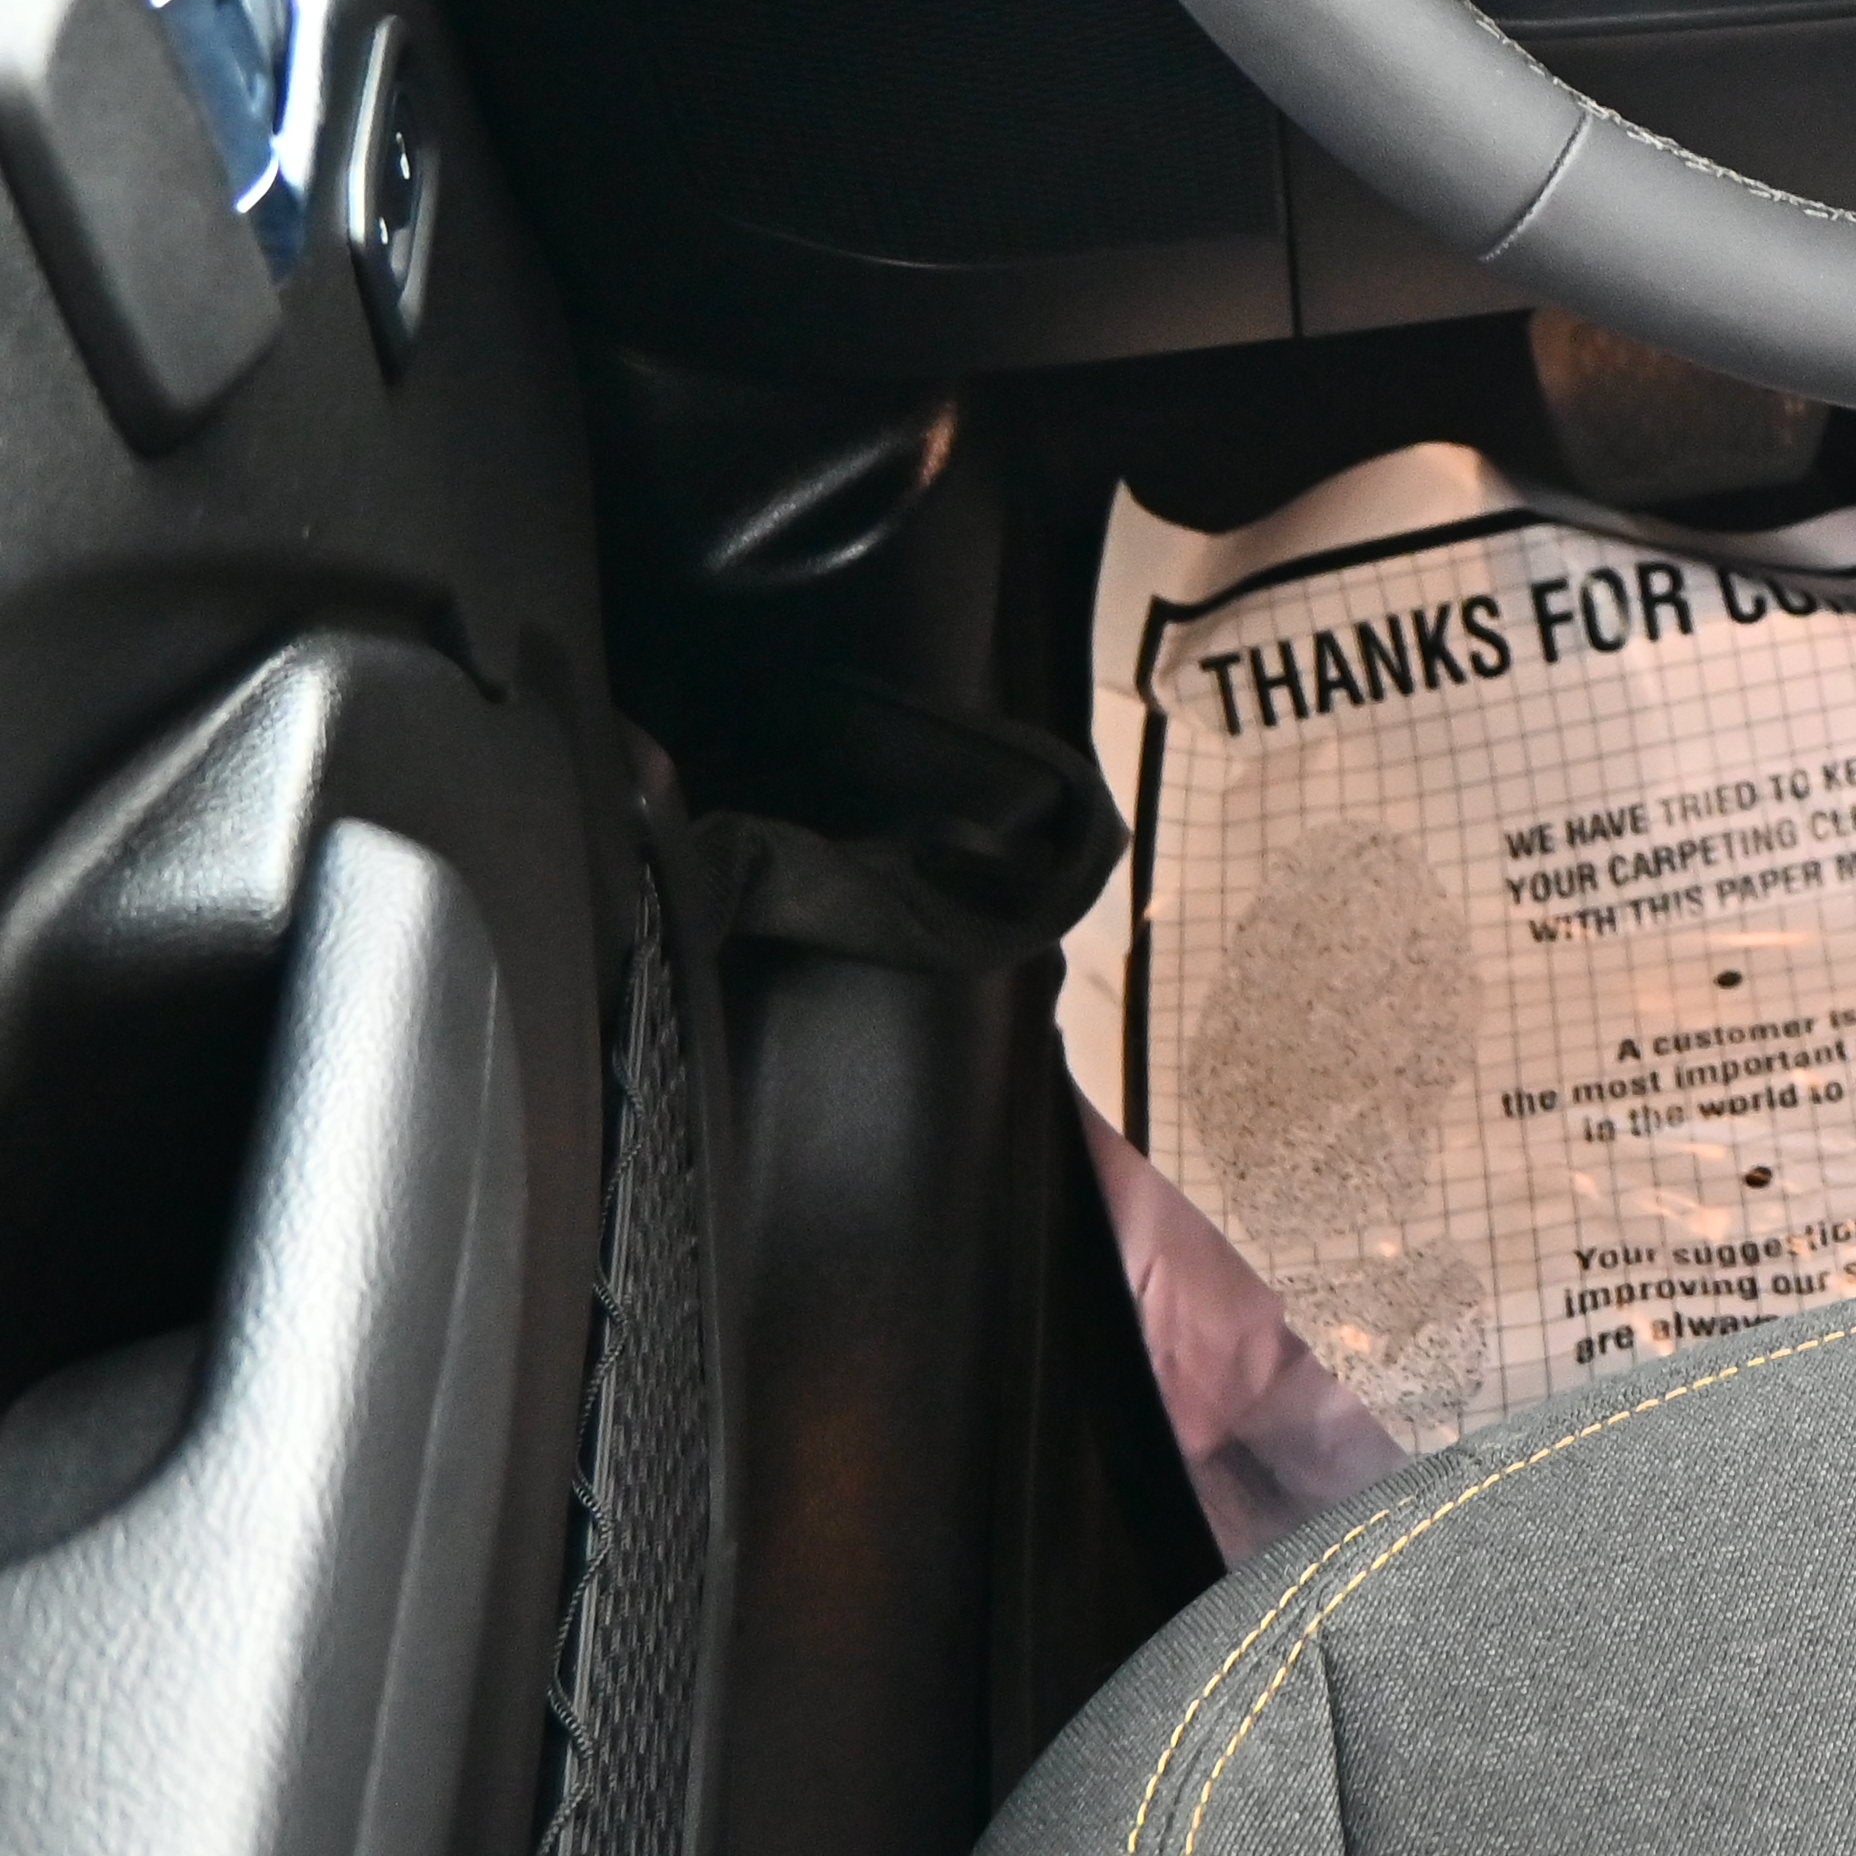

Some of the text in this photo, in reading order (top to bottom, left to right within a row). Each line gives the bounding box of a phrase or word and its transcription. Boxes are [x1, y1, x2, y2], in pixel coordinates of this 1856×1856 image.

[1199, 594, 1513, 738] THANKS
[1530, 561, 1694, 665] FOR
[1503, 819, 1557, 861] WE
[1565, 802, 1650, 849] HAVE
[1660, 779, 1758, 828] TRIED
[1768, 768, 1812, 804] TO
[1505, 860, 1600, 906] YOUR
[1607, 817, 1799, 889] CARPETING
[1528, 902, 1619, 944] WITH
[1630, 884, 1706, 927] THIS
[1715, 858, 1825, 908] PAPER
[1617, 1037, 1642, 1063] A
[1652, 1016, 1817, 1057] customer
[1500, 1087, 1560, 1121] the
[1571, 1069, 1663, 1107] most
[1673, 1037, 1850, 1092] important
[1582, 1114, 1617, 1145] in
[1628, 1101, 1686, 1140] the
[1696, 1082, 1800, 1123] world
[1808, 1077, 1845, 1107] to
[1564, 1270, 1760, 1320] improving
[1770, 1266, 1832, 1298] our
[1573, 1246, 1657, 1273] Your
[1574, 1320, 1636, 1366] are
